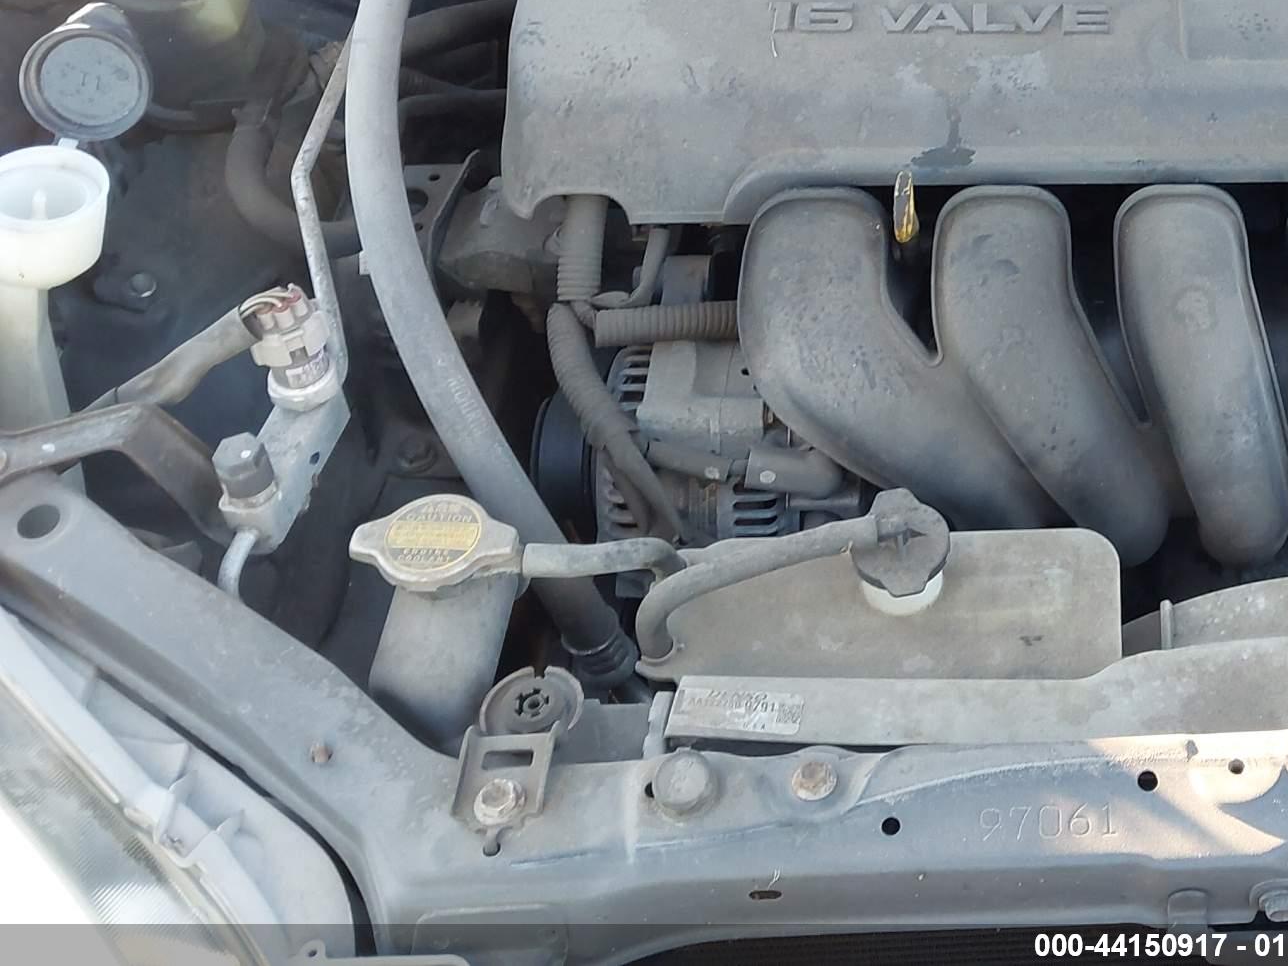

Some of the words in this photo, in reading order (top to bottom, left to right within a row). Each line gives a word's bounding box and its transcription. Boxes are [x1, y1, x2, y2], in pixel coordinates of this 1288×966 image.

[768, 0, 855, 34] 16
[879, 2, 1112, 35] VALVE
[406, 513, 472, 523] CAUTION
[398, 554, 450, 563] COOLANT
[979, 802, 1119, 842] 97061
